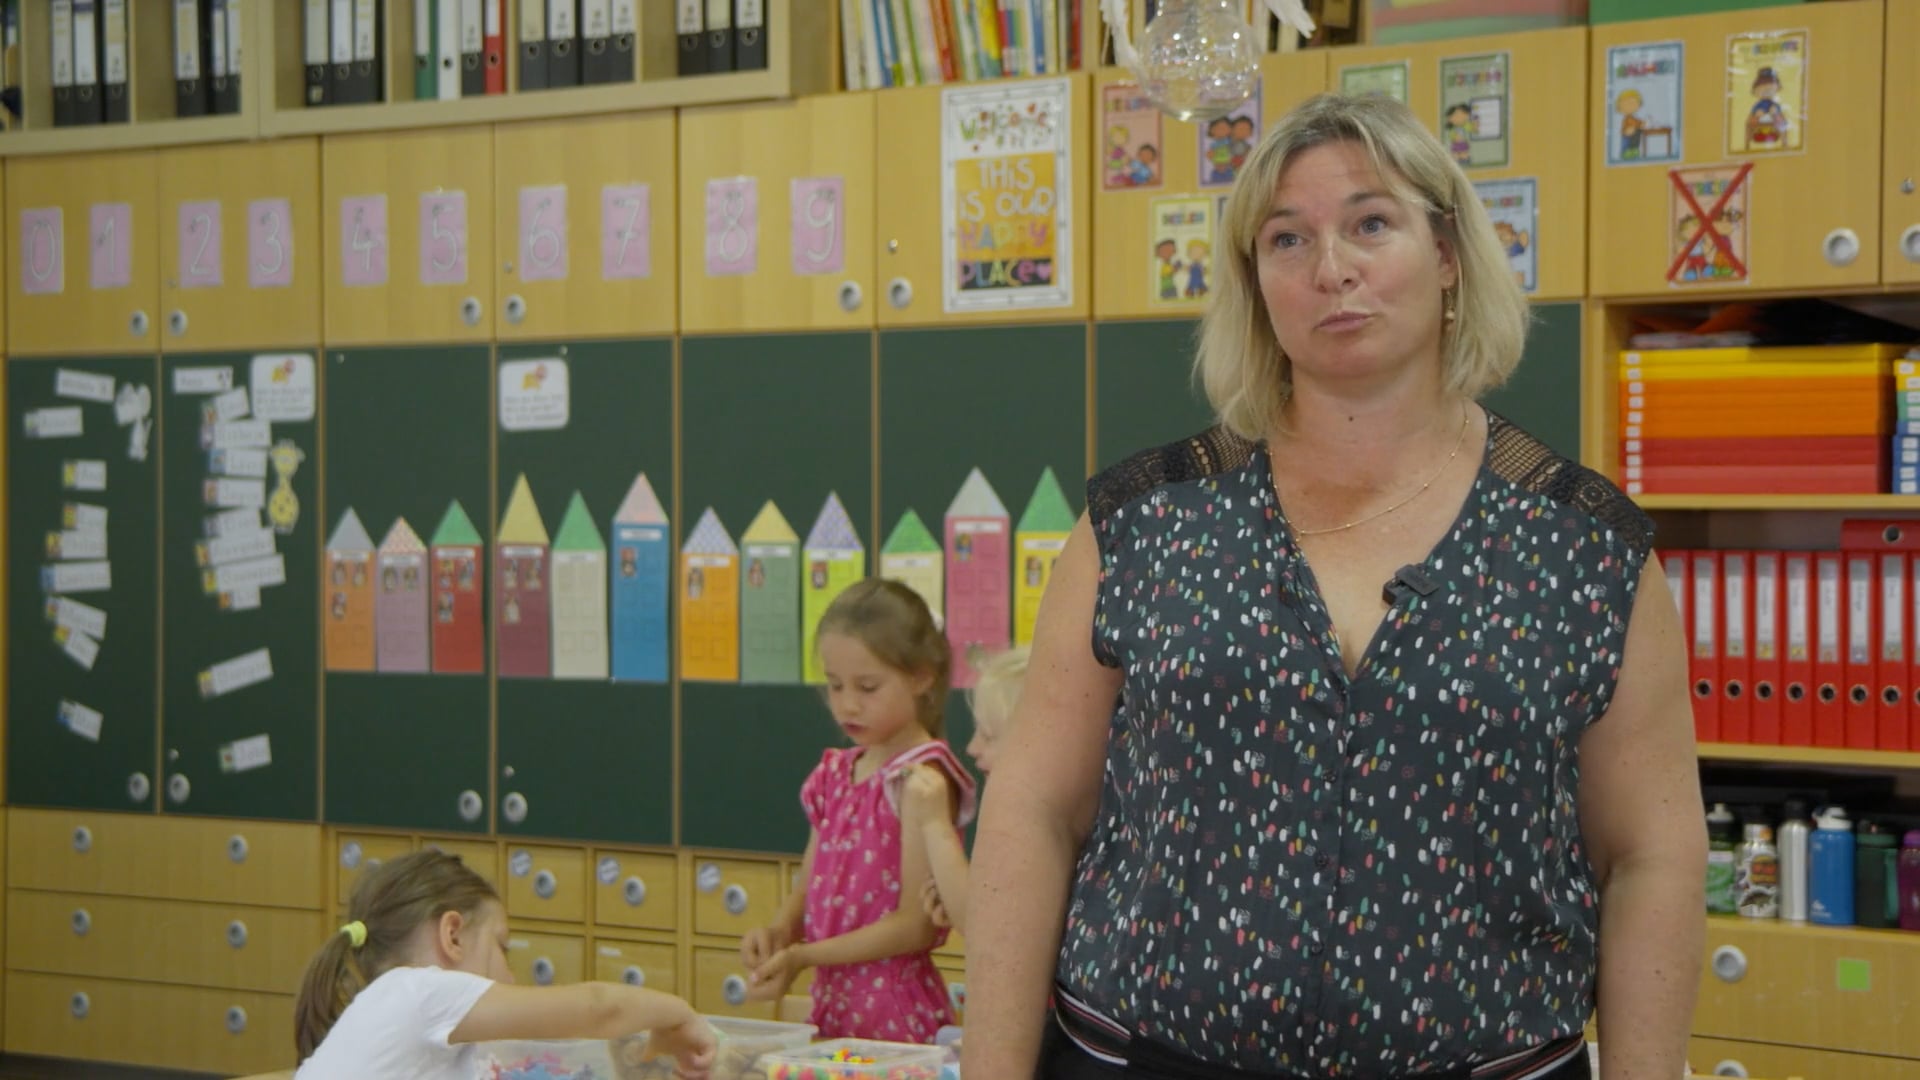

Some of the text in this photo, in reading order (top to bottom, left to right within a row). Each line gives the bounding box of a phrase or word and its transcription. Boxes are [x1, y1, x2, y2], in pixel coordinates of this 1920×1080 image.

[31, 219, 55, 281] 0
[97, 216, 115, 273] 1
[189, 211, 212, 275] 2
[259, 209, 283, 274] 3
[352, 205, 379, 272] 4
[431, 203, 458, 272] 5
[529, 198, 560, 269] 6
[614, 197, 641, 266] 7
[718, 190, 748, 263] 8
[806, 187, 836, 264] 9
